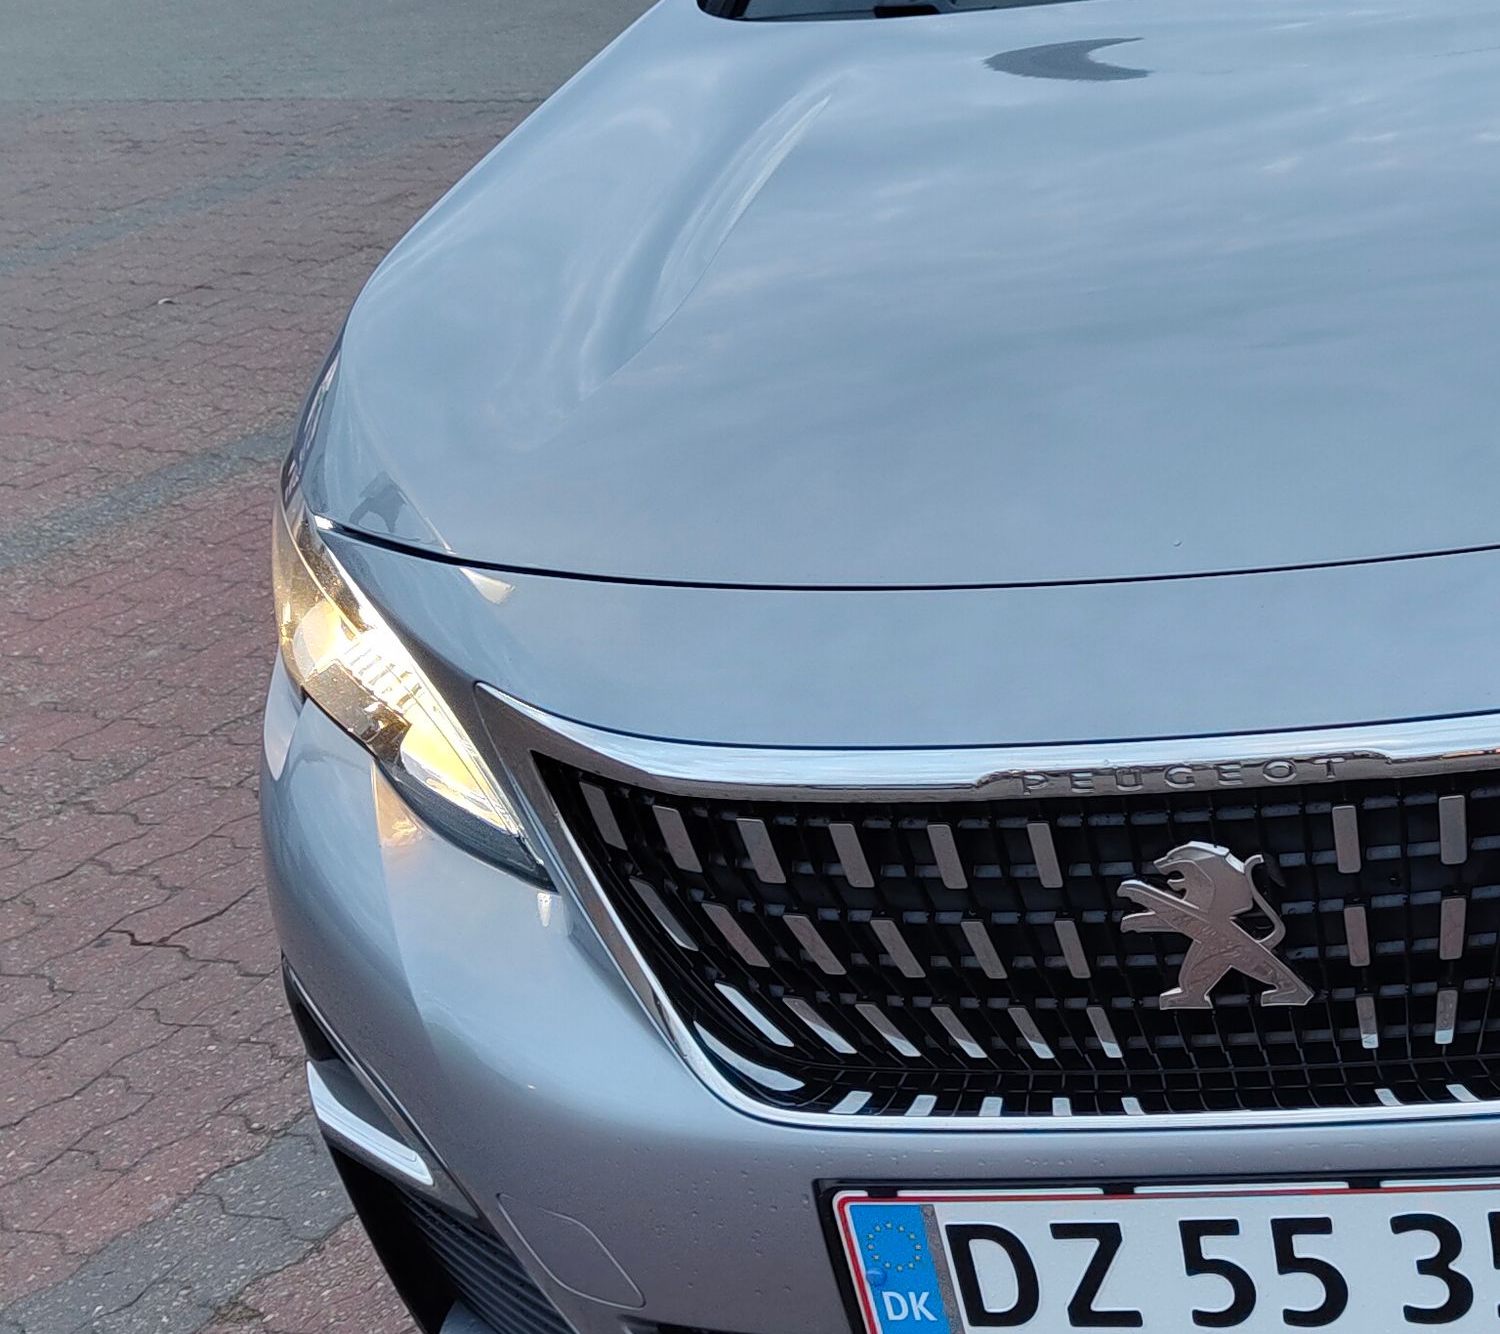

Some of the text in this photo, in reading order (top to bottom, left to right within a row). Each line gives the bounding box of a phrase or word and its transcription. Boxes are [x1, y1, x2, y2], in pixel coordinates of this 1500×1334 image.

[1020, 756, 1345, 796] PEUGEOT
[944, 1220, 1144, 1329] DZ
[1178, 1217, 1350, 1329] 55
[882, 1289, 938, 1324] DK
